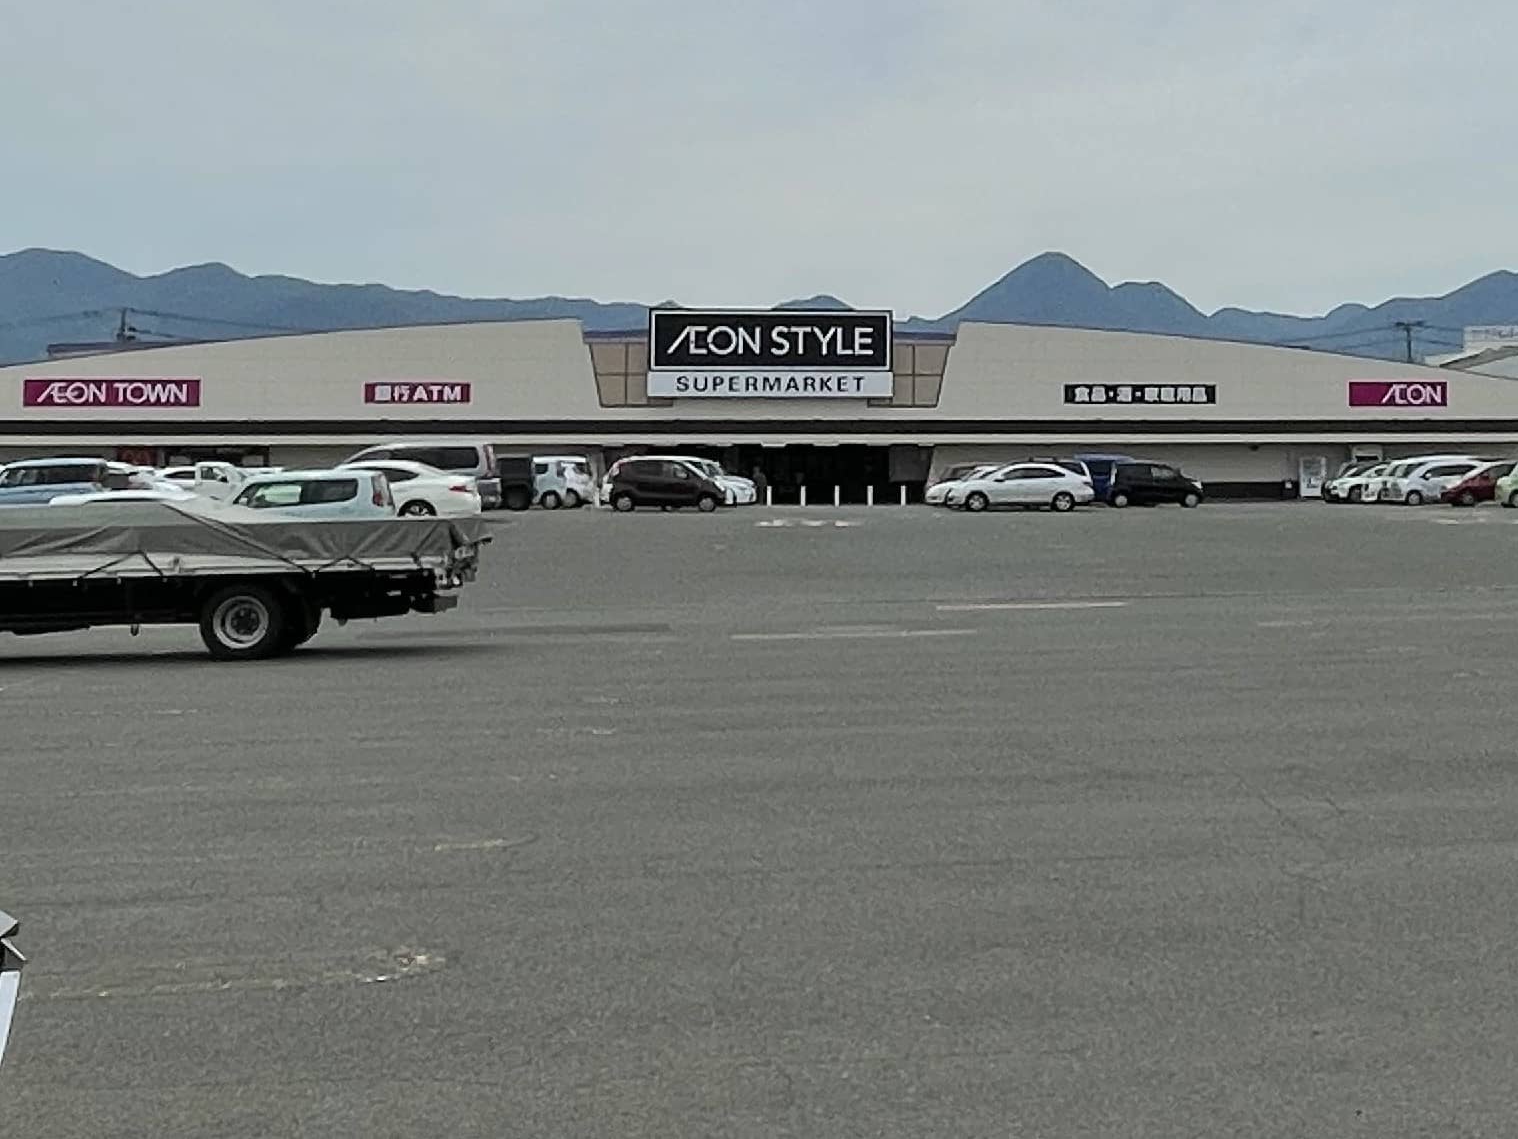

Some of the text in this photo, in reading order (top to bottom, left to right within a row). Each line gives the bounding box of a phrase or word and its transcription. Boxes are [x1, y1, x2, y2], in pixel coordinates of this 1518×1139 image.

[770, 326, 874, 356] STYLE
[113, 382, 188, 404] TOWN
[676, 375, 865, 392] SUPERMARKET
